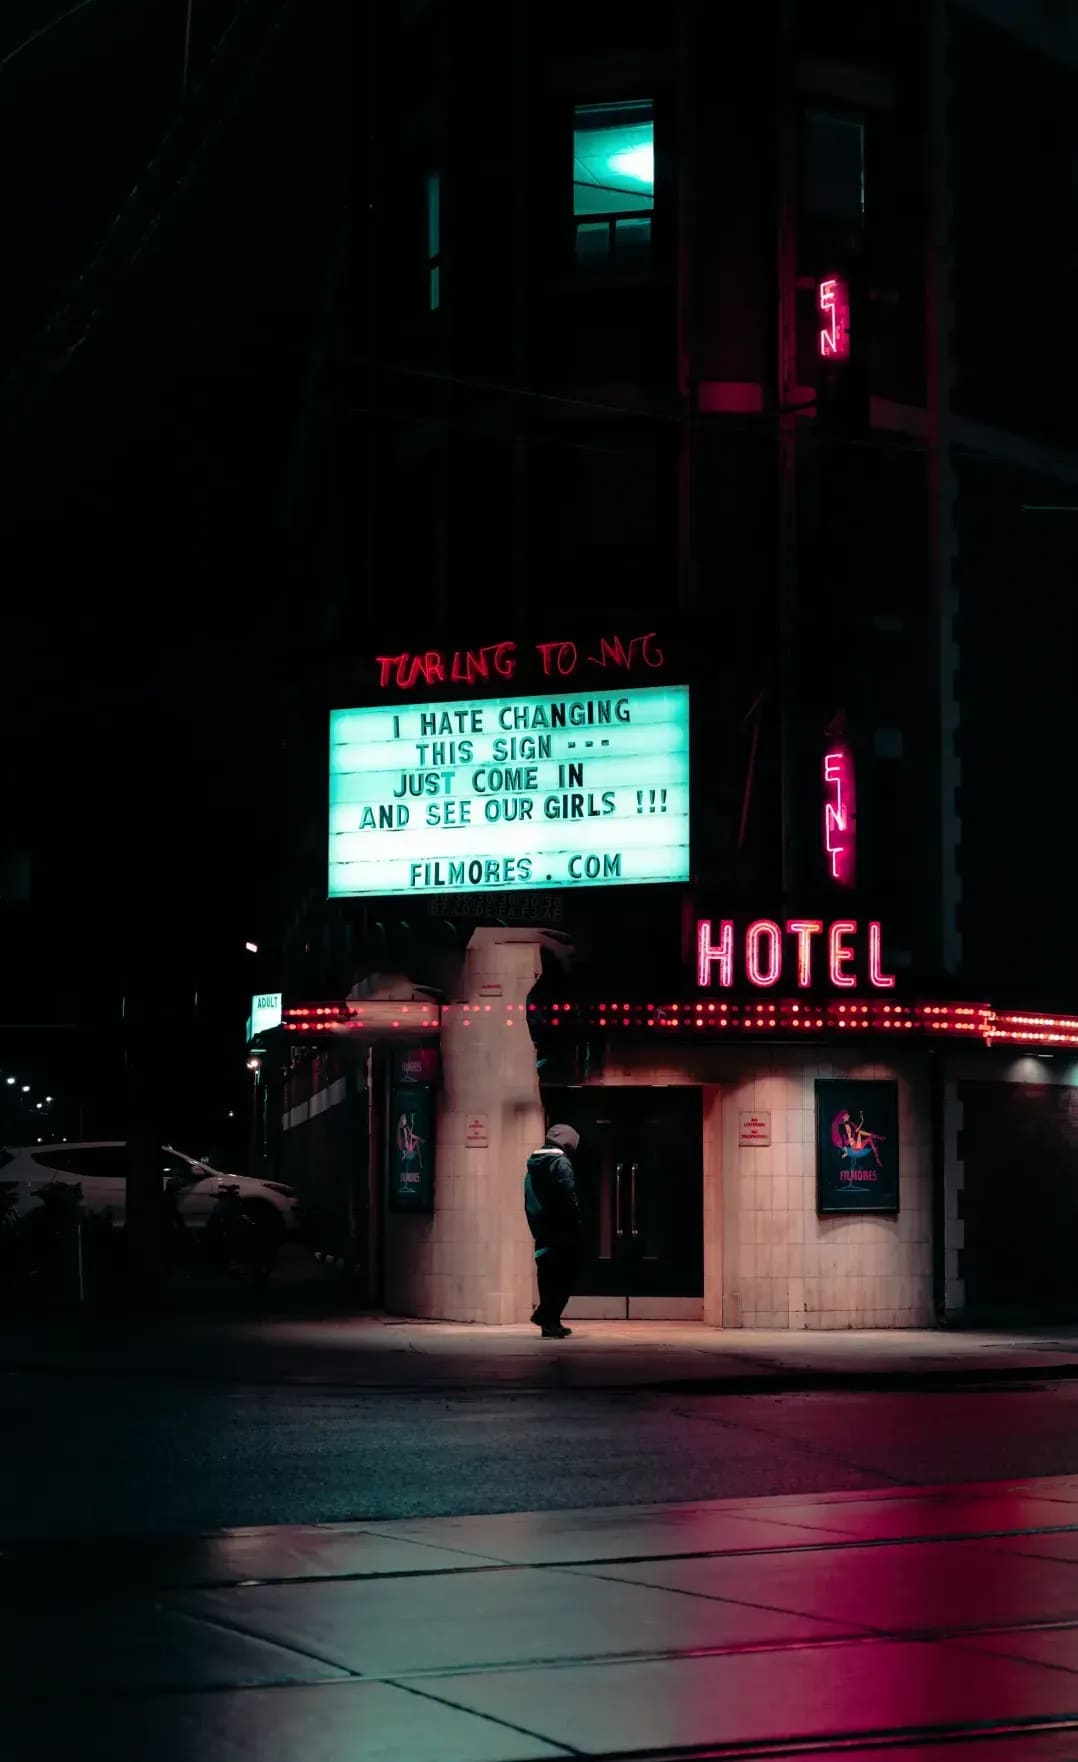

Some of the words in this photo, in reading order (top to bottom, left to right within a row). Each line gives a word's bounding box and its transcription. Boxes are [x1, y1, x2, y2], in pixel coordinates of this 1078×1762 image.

[393, 716, 400, 738] I
[421, 710, 483, 736] HATE
[500, 699, 631, 730] CHANGING
[416, 741, 473, 766] THIS
[492, 735, 552, 762] SIGN
[393, 771, 456, 798] JUST
[472, 767, 538, 793] COME
[558, 763, 583, 788] IN
[359, 804, 410, 829] AND
[426, 801, 471, 825] SEE
[484, 798, 533, 822] OUR
[544, 792, 616, 819] GIRLS
[410, 858, 532, 886] FILMORES
[568, 853, 622, 878] COM
[698, 919, 895, 987] HOTEL
[257, 997, 278, 1008] ADULT
